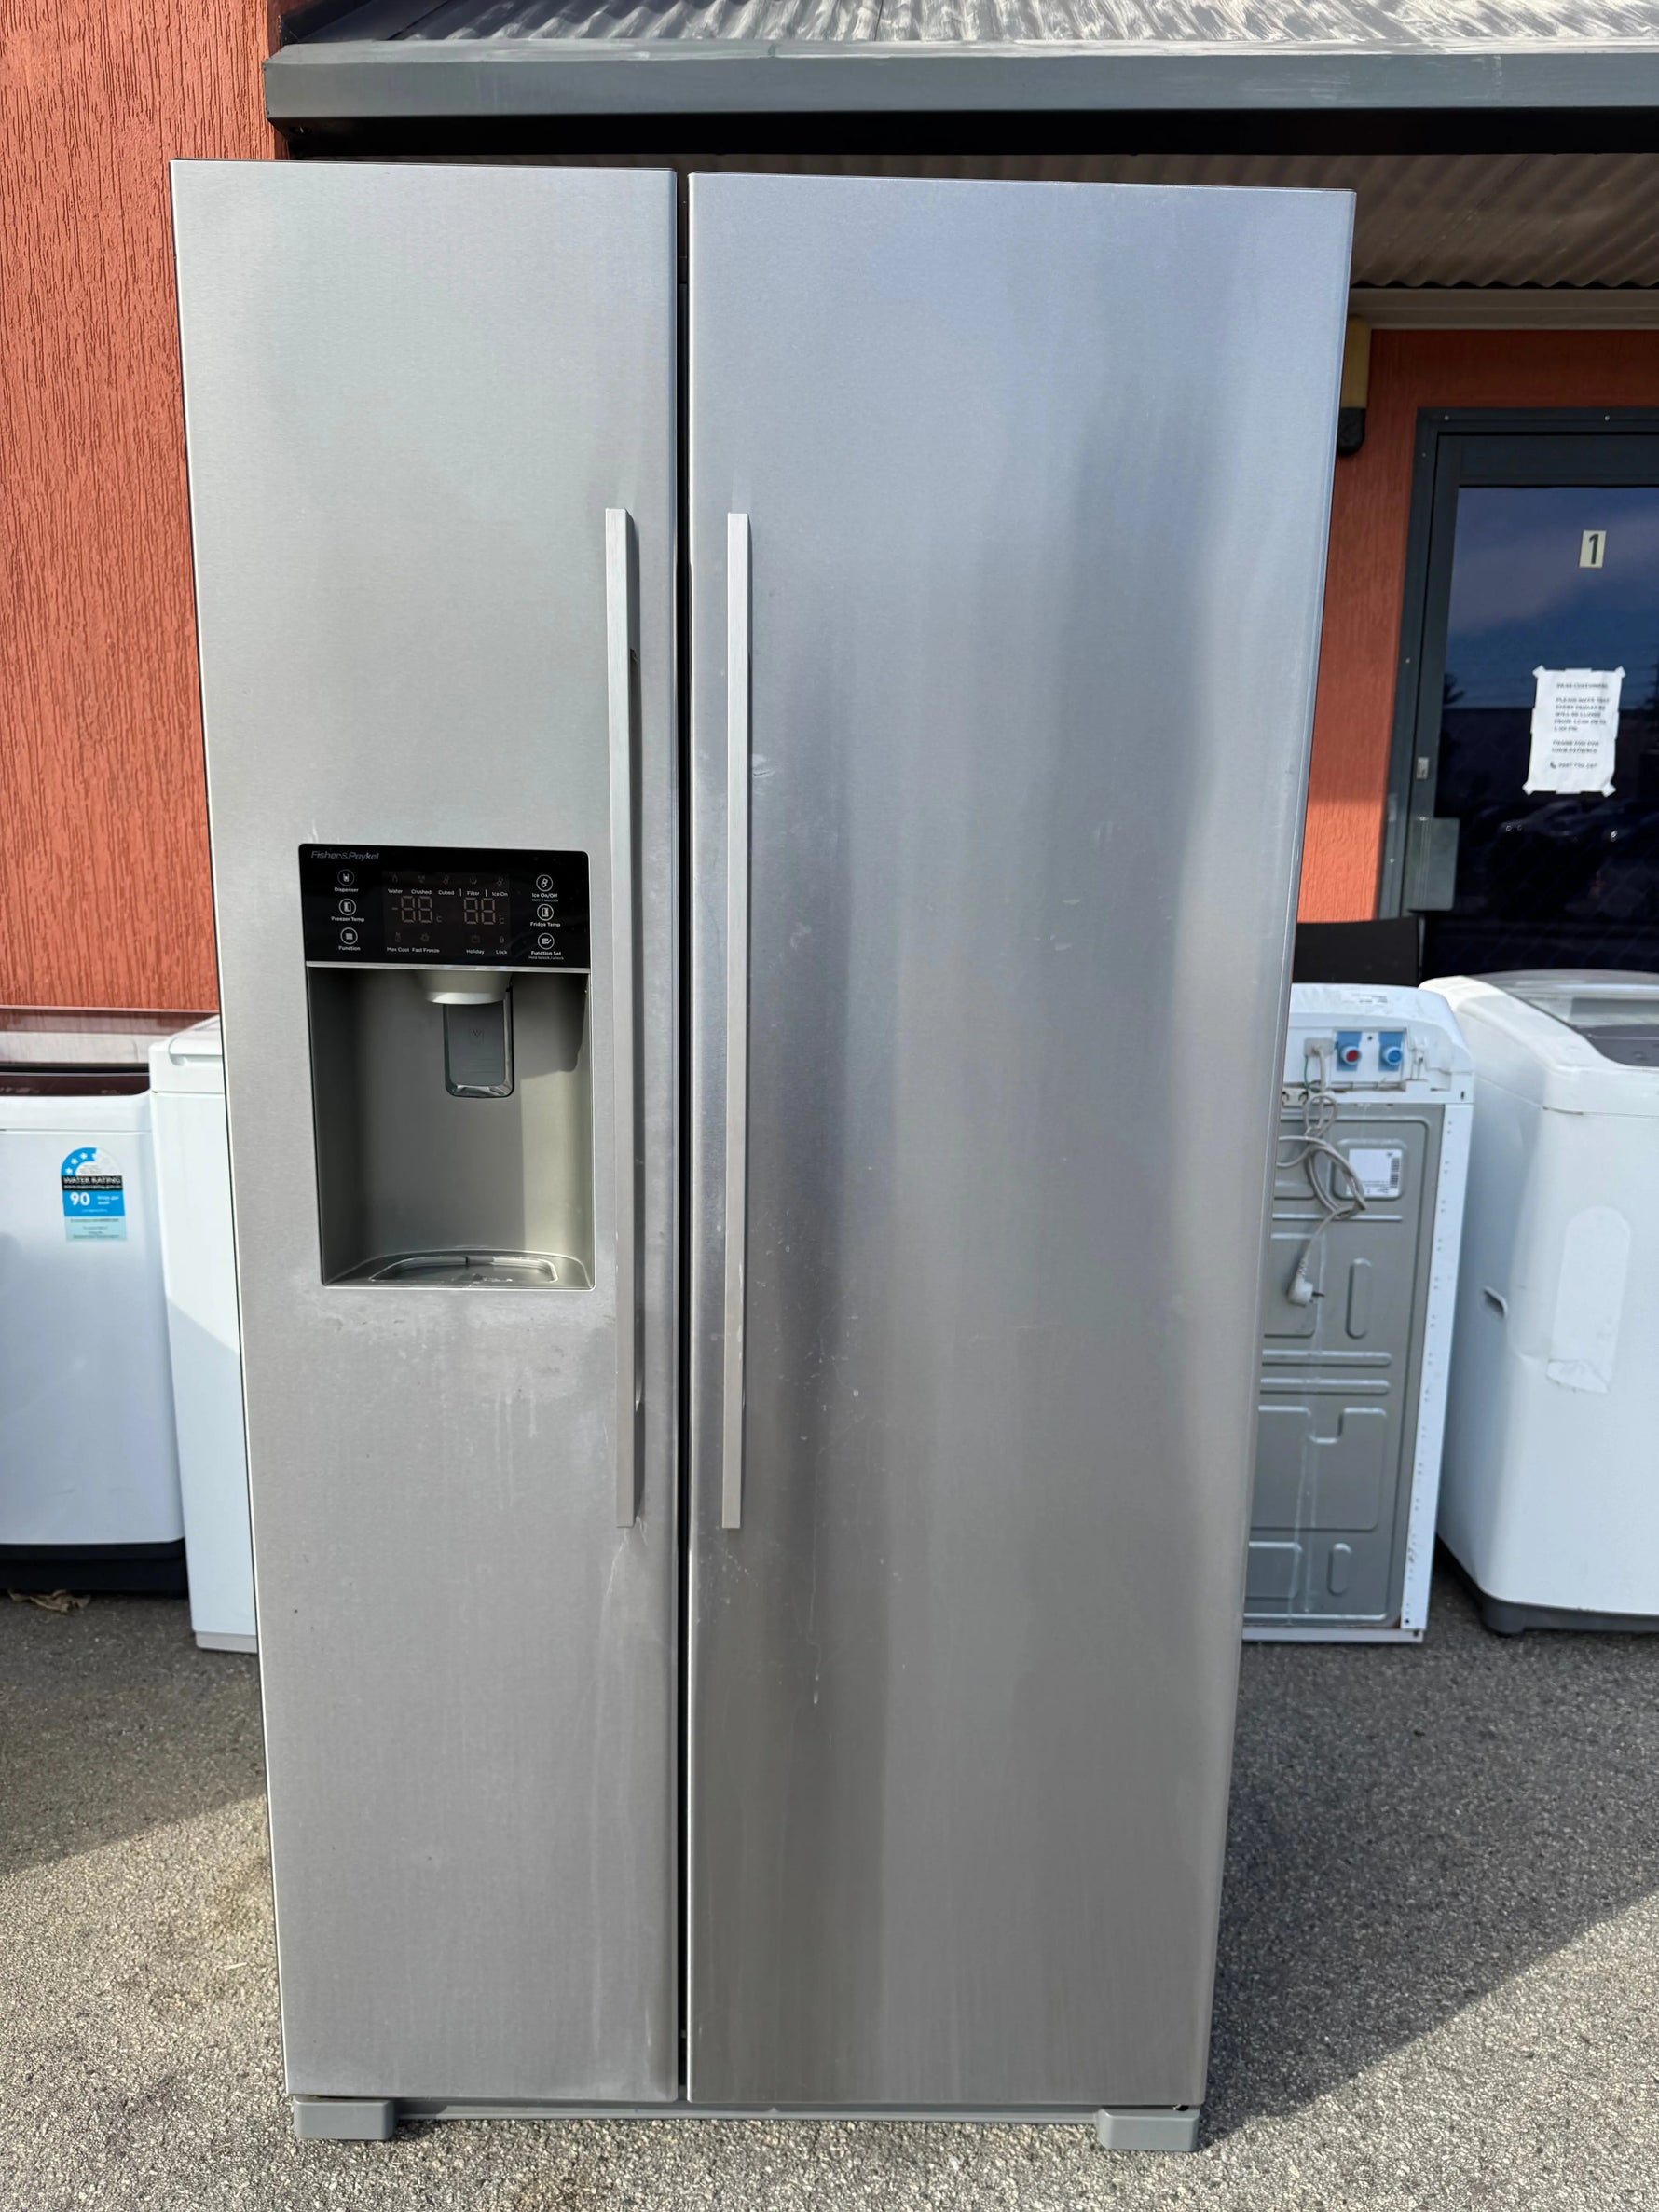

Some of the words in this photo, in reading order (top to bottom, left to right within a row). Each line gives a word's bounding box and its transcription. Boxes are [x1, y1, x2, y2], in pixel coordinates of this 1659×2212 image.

[1588, 533, 1599, 565] 1
[310, 850, 380, 861] Fisher&Paykel
[70, 1191, 90, 1206] 90
